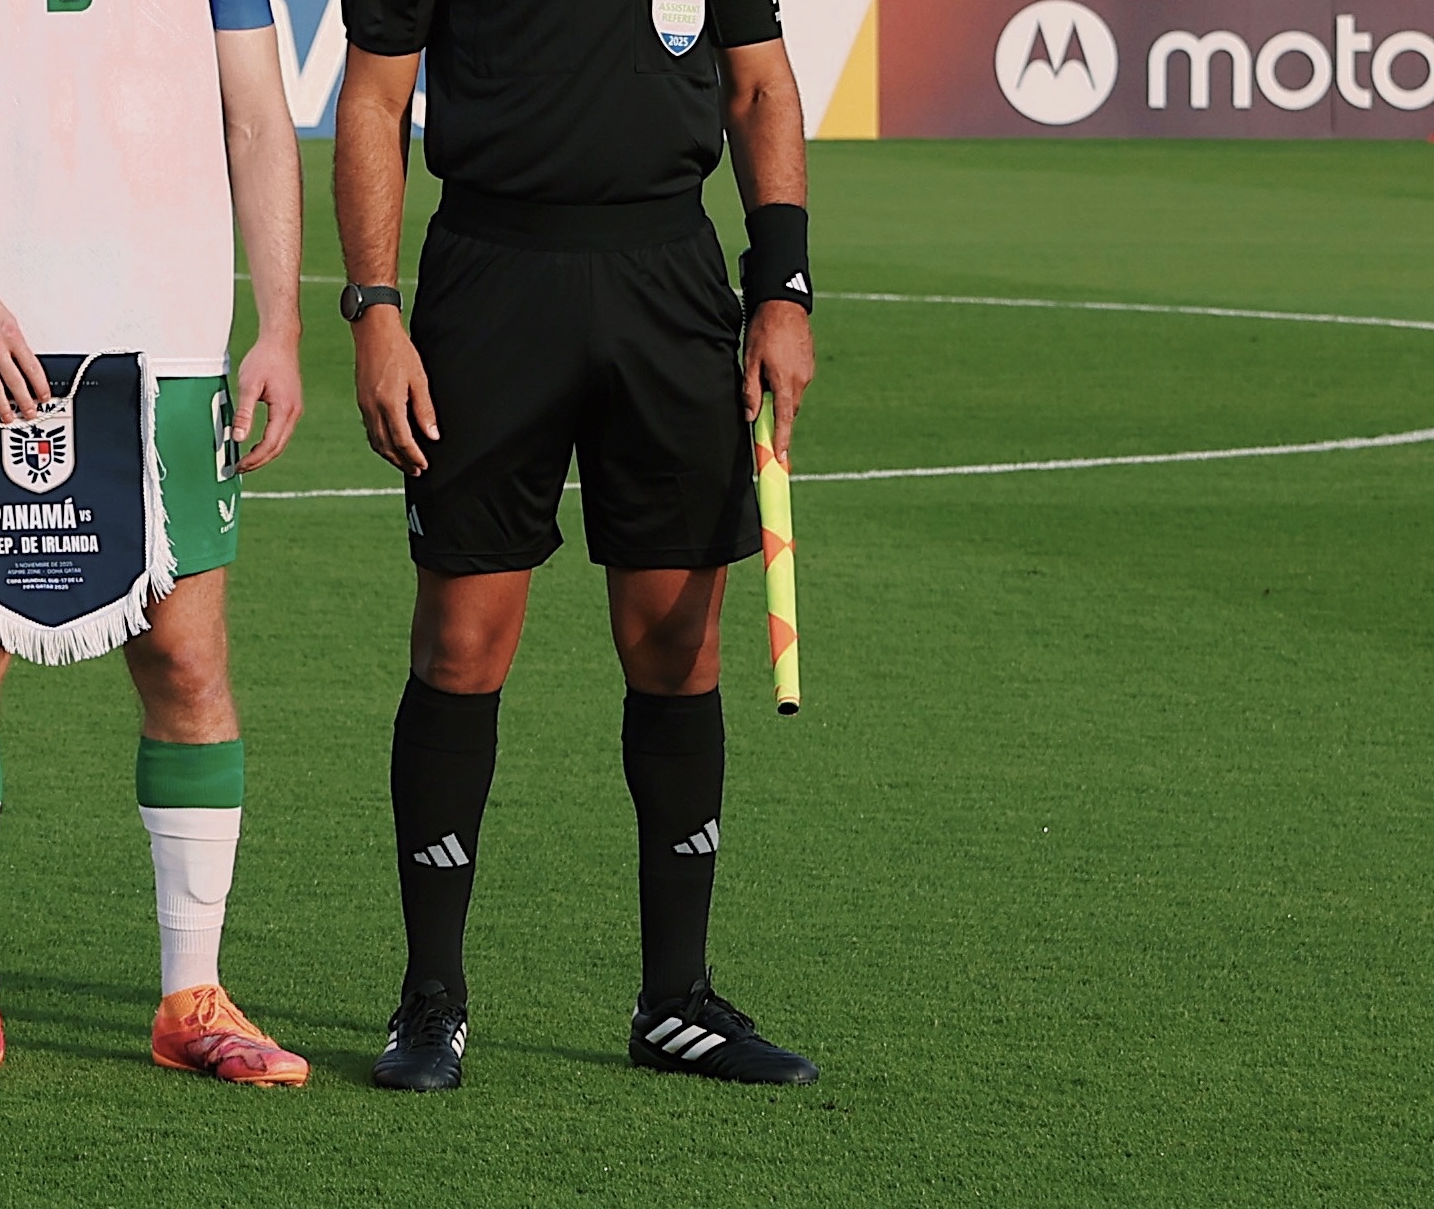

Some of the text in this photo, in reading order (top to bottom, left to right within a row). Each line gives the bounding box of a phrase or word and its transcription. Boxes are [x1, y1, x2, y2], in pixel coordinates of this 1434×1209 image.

[659, 2, 701, 13] ASSISTANT
[662, 13, 697, 25] REFEREE
[668, 36, 689, 47] 2025
[21, 536, 39, 553] DE
[41, 535, 99, 553] IRLANDA
